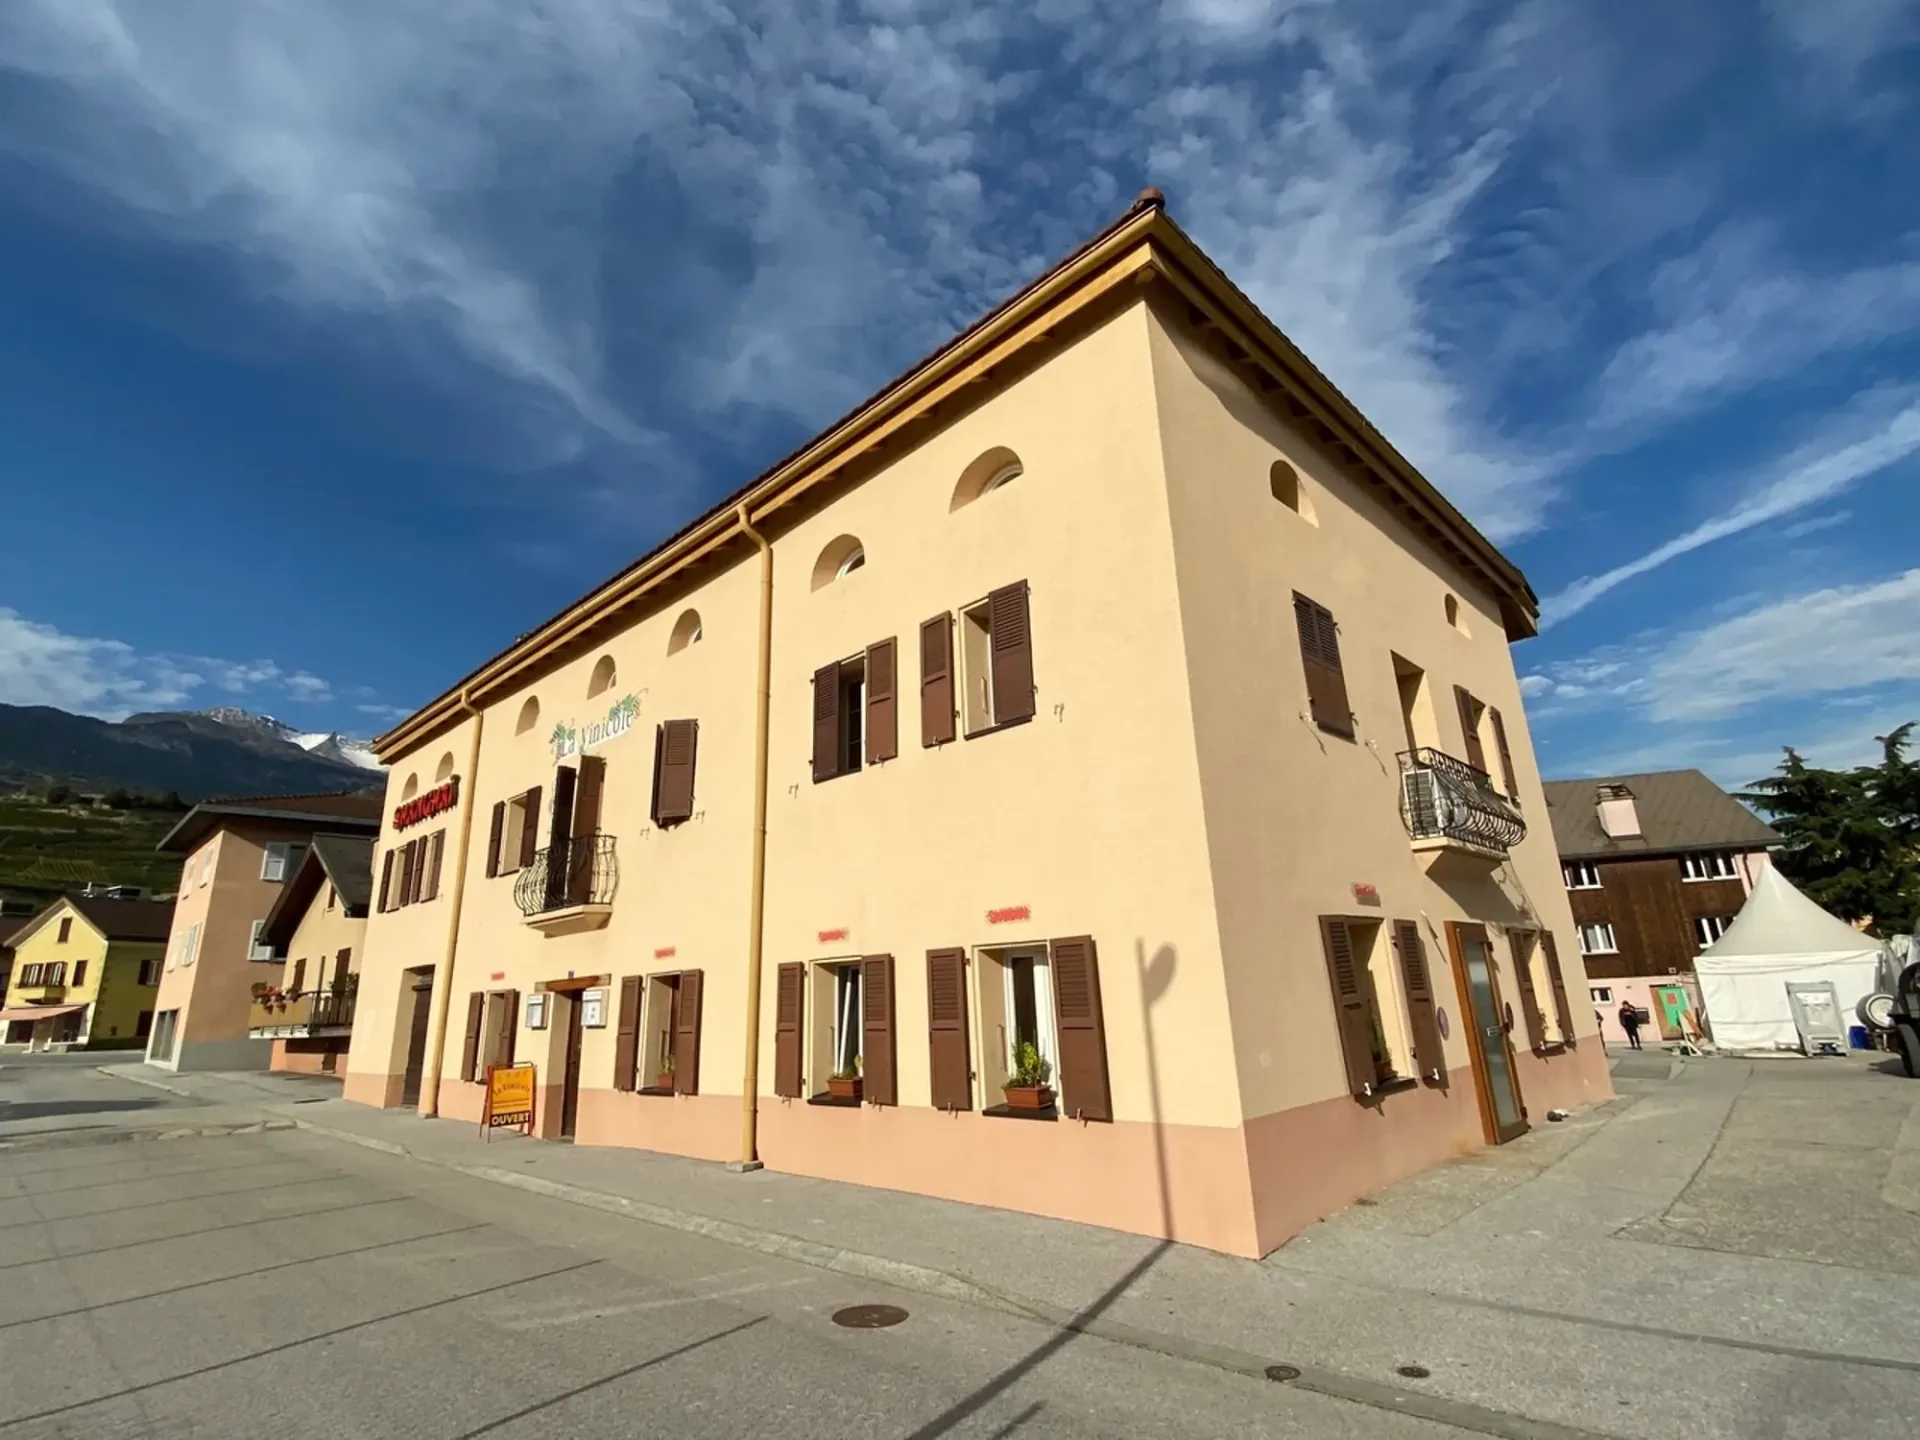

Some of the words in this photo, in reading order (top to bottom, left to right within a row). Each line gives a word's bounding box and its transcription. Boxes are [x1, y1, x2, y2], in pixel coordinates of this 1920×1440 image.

[556, 735, 576, 758] La
[581, 706, 634, 747] Vinicole
[491, 1112, 530, 1126] OUVERT
